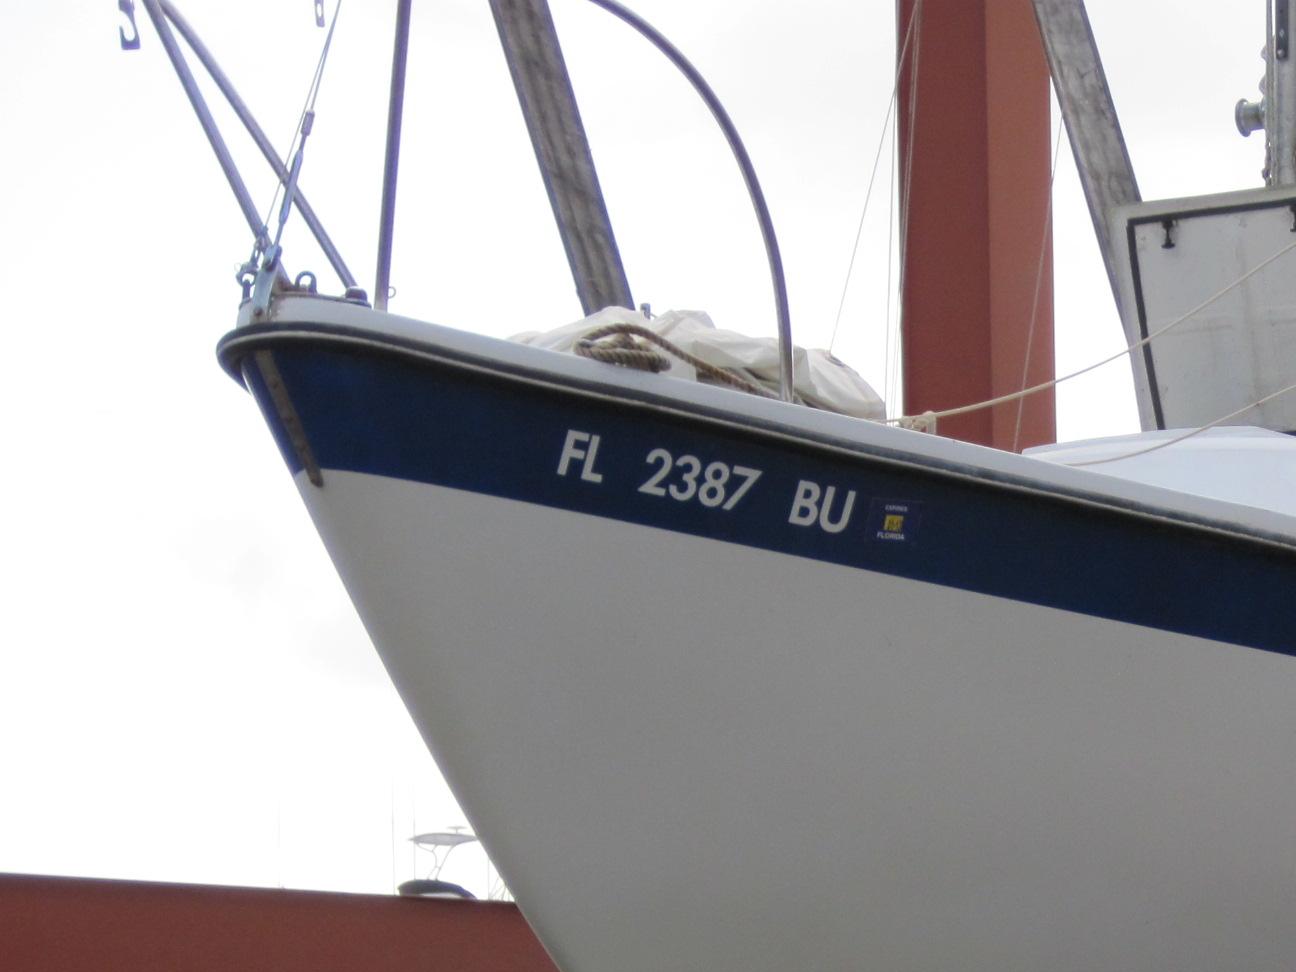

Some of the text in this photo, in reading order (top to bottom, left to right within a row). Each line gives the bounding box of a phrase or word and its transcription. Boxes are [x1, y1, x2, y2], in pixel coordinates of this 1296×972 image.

[556, 429, 856, 534] FL 2387 BU
[876, 531, 905, 540] FLORIDA
